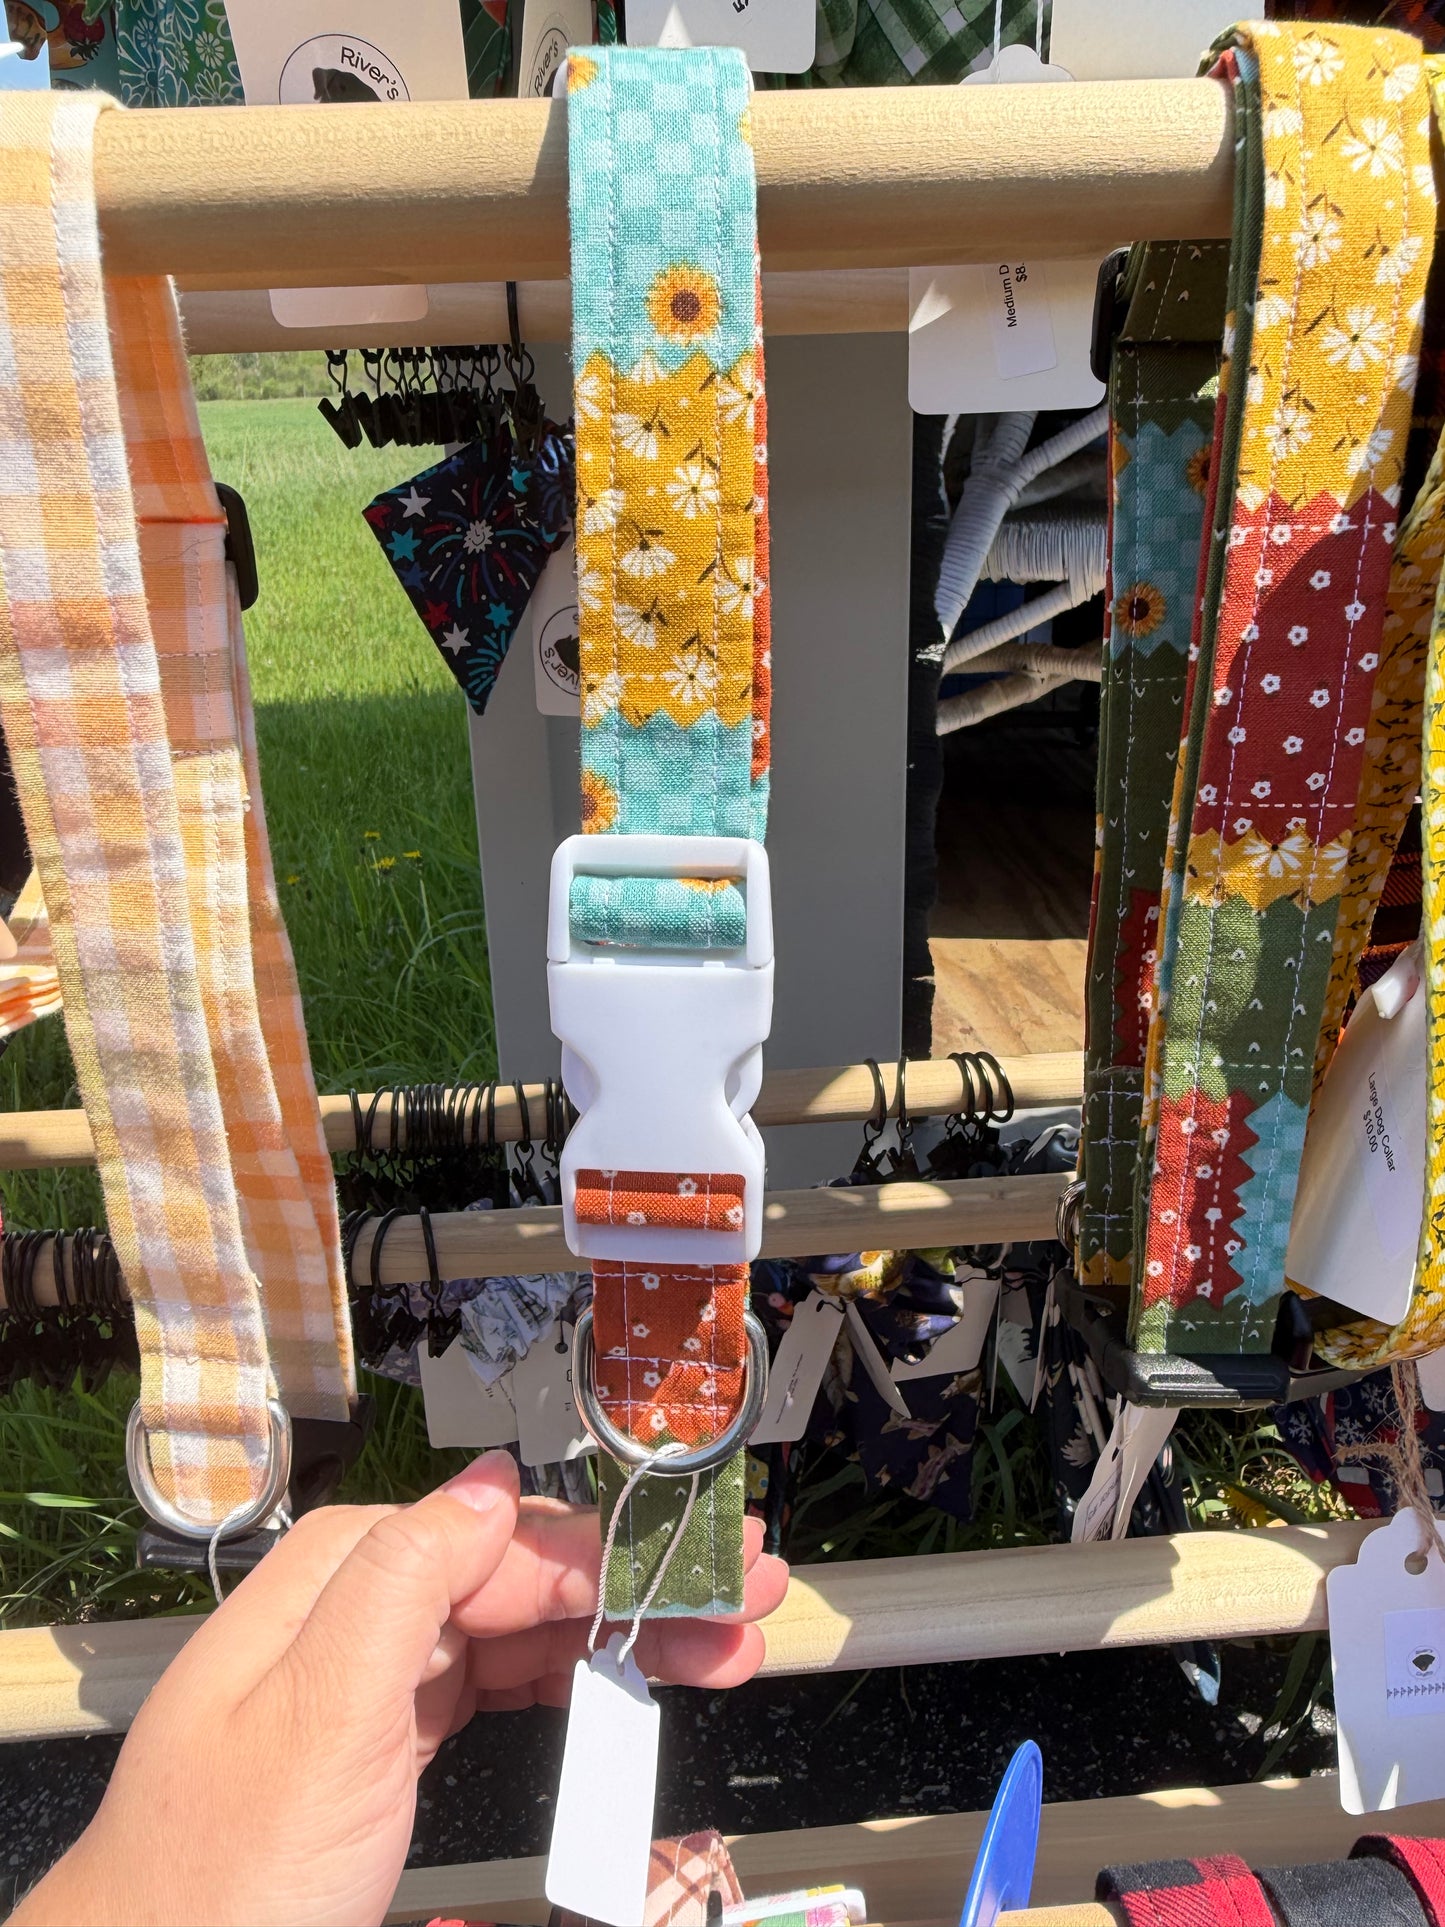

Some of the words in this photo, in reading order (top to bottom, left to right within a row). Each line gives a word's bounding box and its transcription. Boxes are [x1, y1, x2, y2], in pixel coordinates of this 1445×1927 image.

[340, 46, 399, 101] River's
[1002, 278, 1018, 328] Medium
[544, 647, 580, 690] iver's
[1363, 1109, 1379, 1153] $10.00
[1367, 1071, 1379, 1107] Large
[1374, 1106, 1385, 1136] Dog
[1381, 1134, 1396, 1173] Collar
